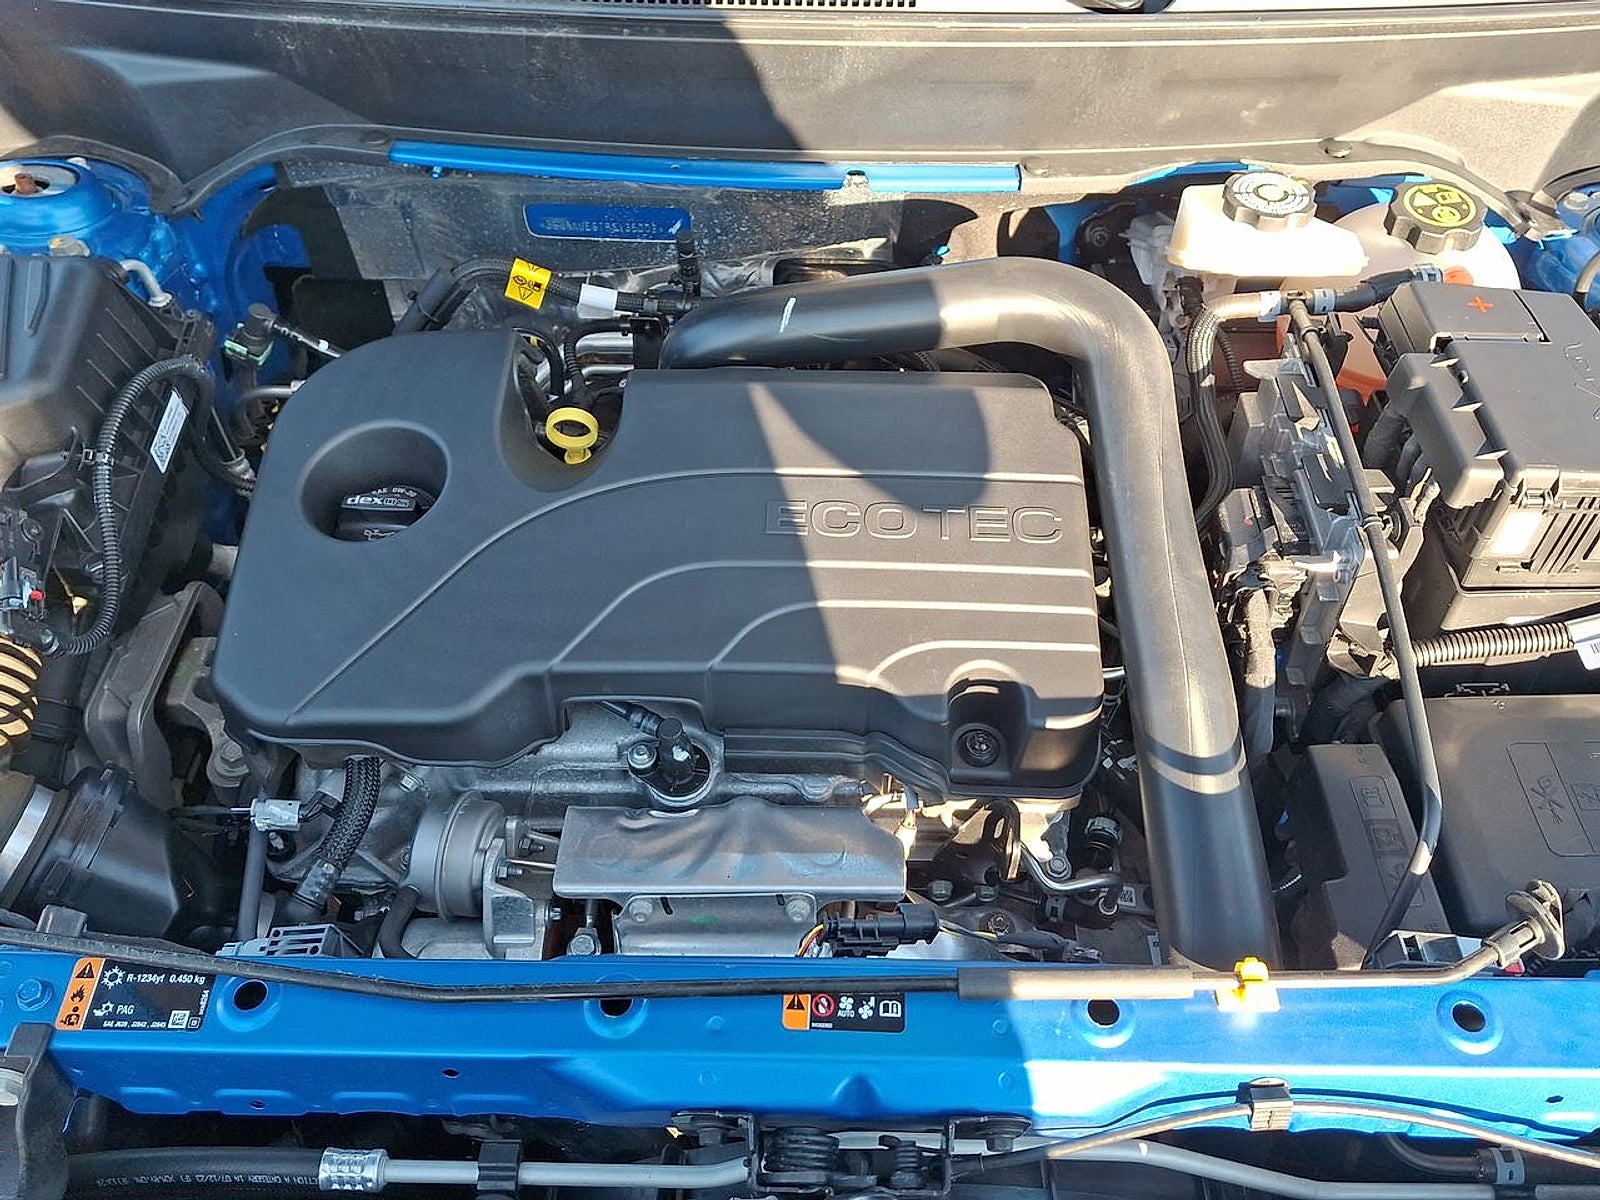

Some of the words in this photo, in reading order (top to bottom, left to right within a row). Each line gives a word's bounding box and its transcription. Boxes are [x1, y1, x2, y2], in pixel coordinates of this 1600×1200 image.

[765, 500, 1063, 544] ECOTEC
[126, 974, 165, 985] R-1234yf
[169, 974, 193, 984] 0.450
[193, 975, 206, 985] kg
[116, 1004, 135, 1015] PAG
[837, 1009, 855, 1018] AUTO
